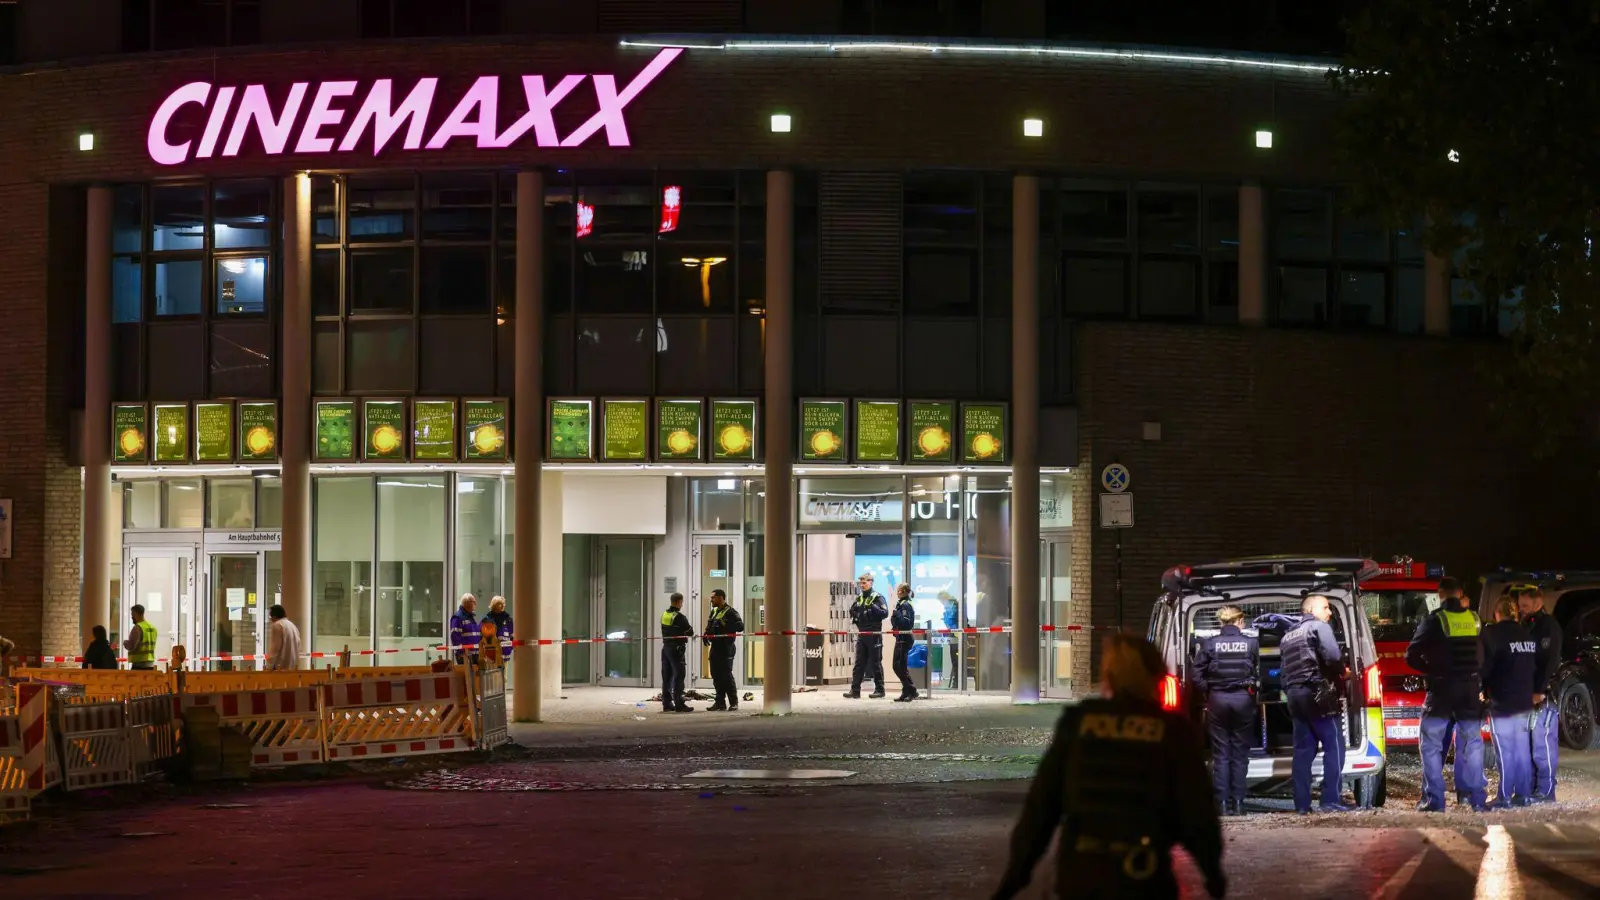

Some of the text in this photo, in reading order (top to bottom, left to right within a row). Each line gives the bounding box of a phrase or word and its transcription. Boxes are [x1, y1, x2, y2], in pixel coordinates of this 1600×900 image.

[147, 47, 685, 165] CINEMAXX
[238, 533, 276, 542] Hauptbahnhof
[1215, 641, 1248, 652] POLIZEI
